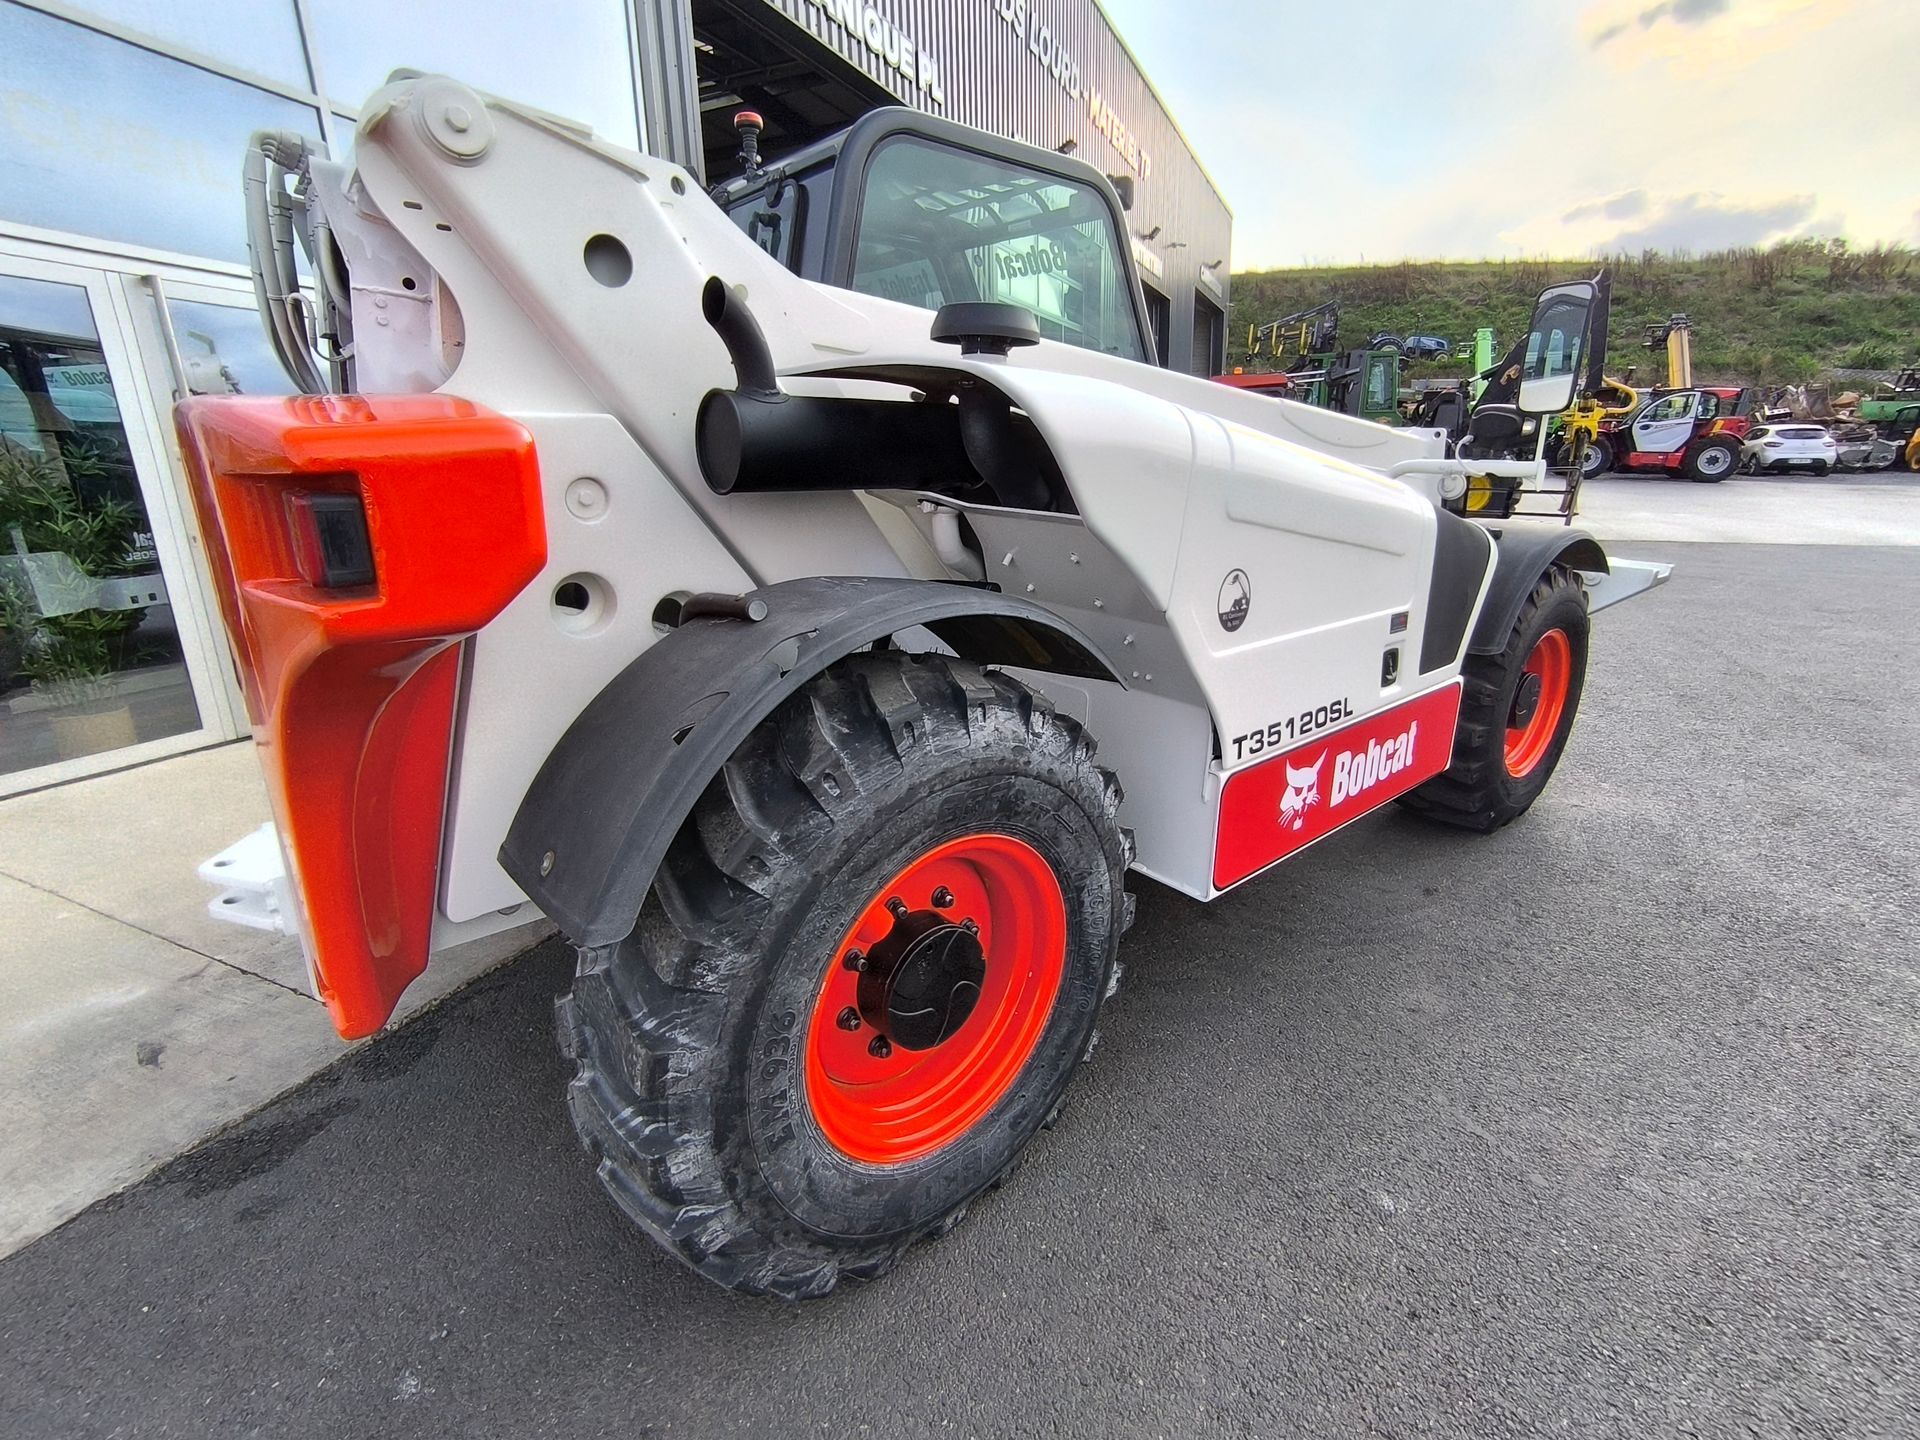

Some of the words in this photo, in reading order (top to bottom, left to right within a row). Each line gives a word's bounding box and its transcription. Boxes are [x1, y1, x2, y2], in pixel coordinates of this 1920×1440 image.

[917, 50, 944, 106] PL
[1029, 10, 1079, 100] LOURD
[1232, 697, 1354, 760] T35120SL
[1329, 719, 1418, 808] Bobcat
